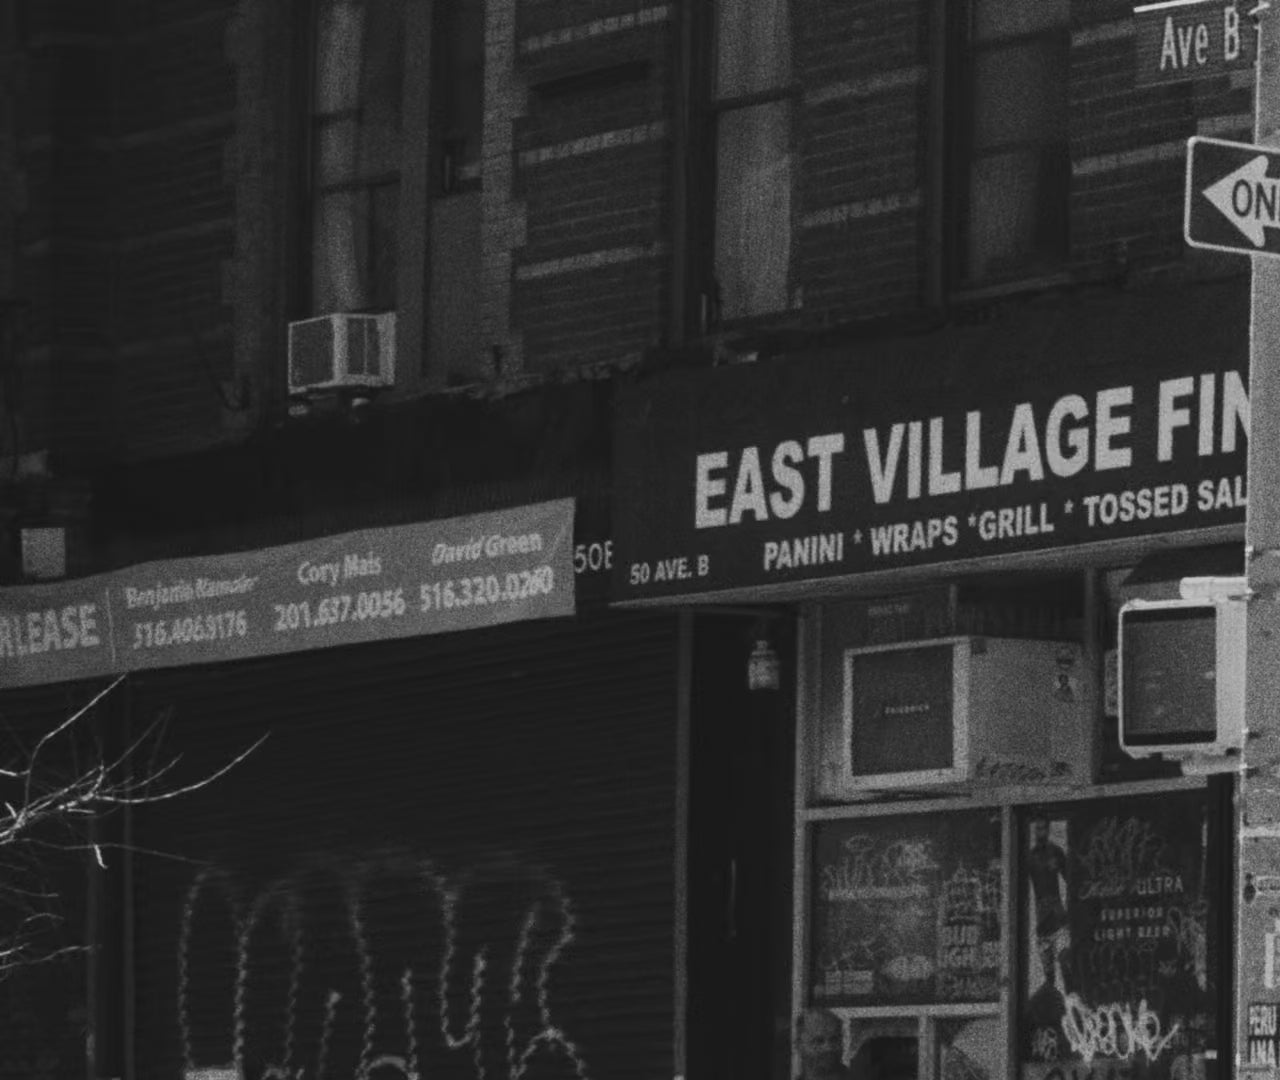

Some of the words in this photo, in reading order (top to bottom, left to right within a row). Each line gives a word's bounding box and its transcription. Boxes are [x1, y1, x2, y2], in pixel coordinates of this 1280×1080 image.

[1160, 16, 1208, 71] Ave
[1224, 5, 1240, 61] B
[695, 432, 846, 529] EAST
[863, 385, 1134, 504] VILLAGE
[763, 532, 844, 571] PANINI
[870, 514, 959, 557] WRAPS
[977, 502, 1055, 541] GRILL
[1083, 481, 1190, 527] TOSSED
[1196, 475, 1250, 514] SAL
[296, 560, 340, 588] Cory
[432, 534, 485, 567] David
[485, 532, 543, 558] Green
[629, 561, 651, 586] 50
[654, 556, 693, 583] AVE.
[696, 553, 710, 577] B
[14, 602, 101, 656] LEASE
[273, 587, 407, 632] 201.637.0056
